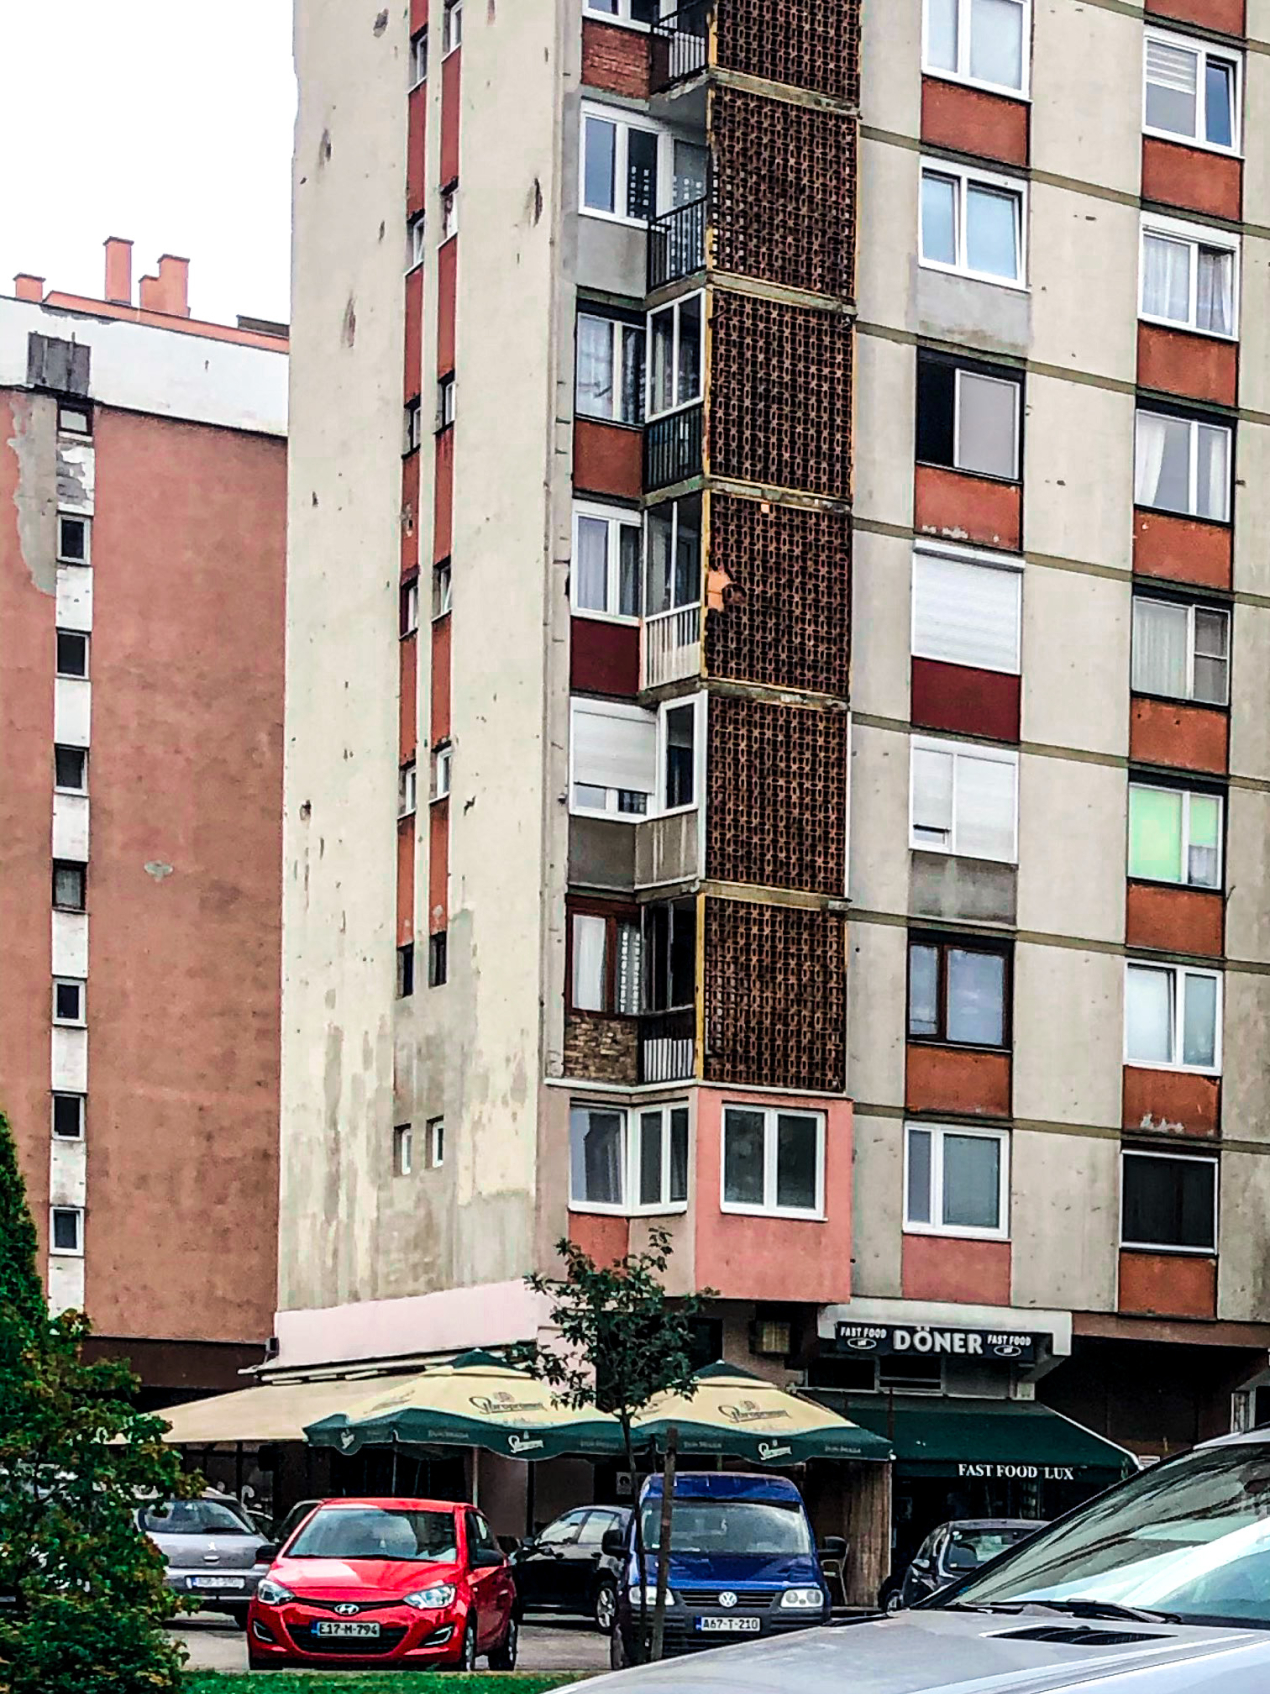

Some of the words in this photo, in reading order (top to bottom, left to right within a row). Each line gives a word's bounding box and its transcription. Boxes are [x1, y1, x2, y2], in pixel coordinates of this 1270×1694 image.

[840, 1326, 862, 1337] FAST
[863, 1328, 887, 1339] FOOD
[893, 1326, 983, 1354] DÖNER
[987, 1334, 1008, 1345] FAST
[1009, 1335, 1031, 1346] FOOD
[958, 1463, 994, 1477] FAST
[996, 1465, 1038, 1478] FOOD
[1044, 1467, 1074, 1480] LUX
[703, 1619, 759, 1630] A67-T-210
